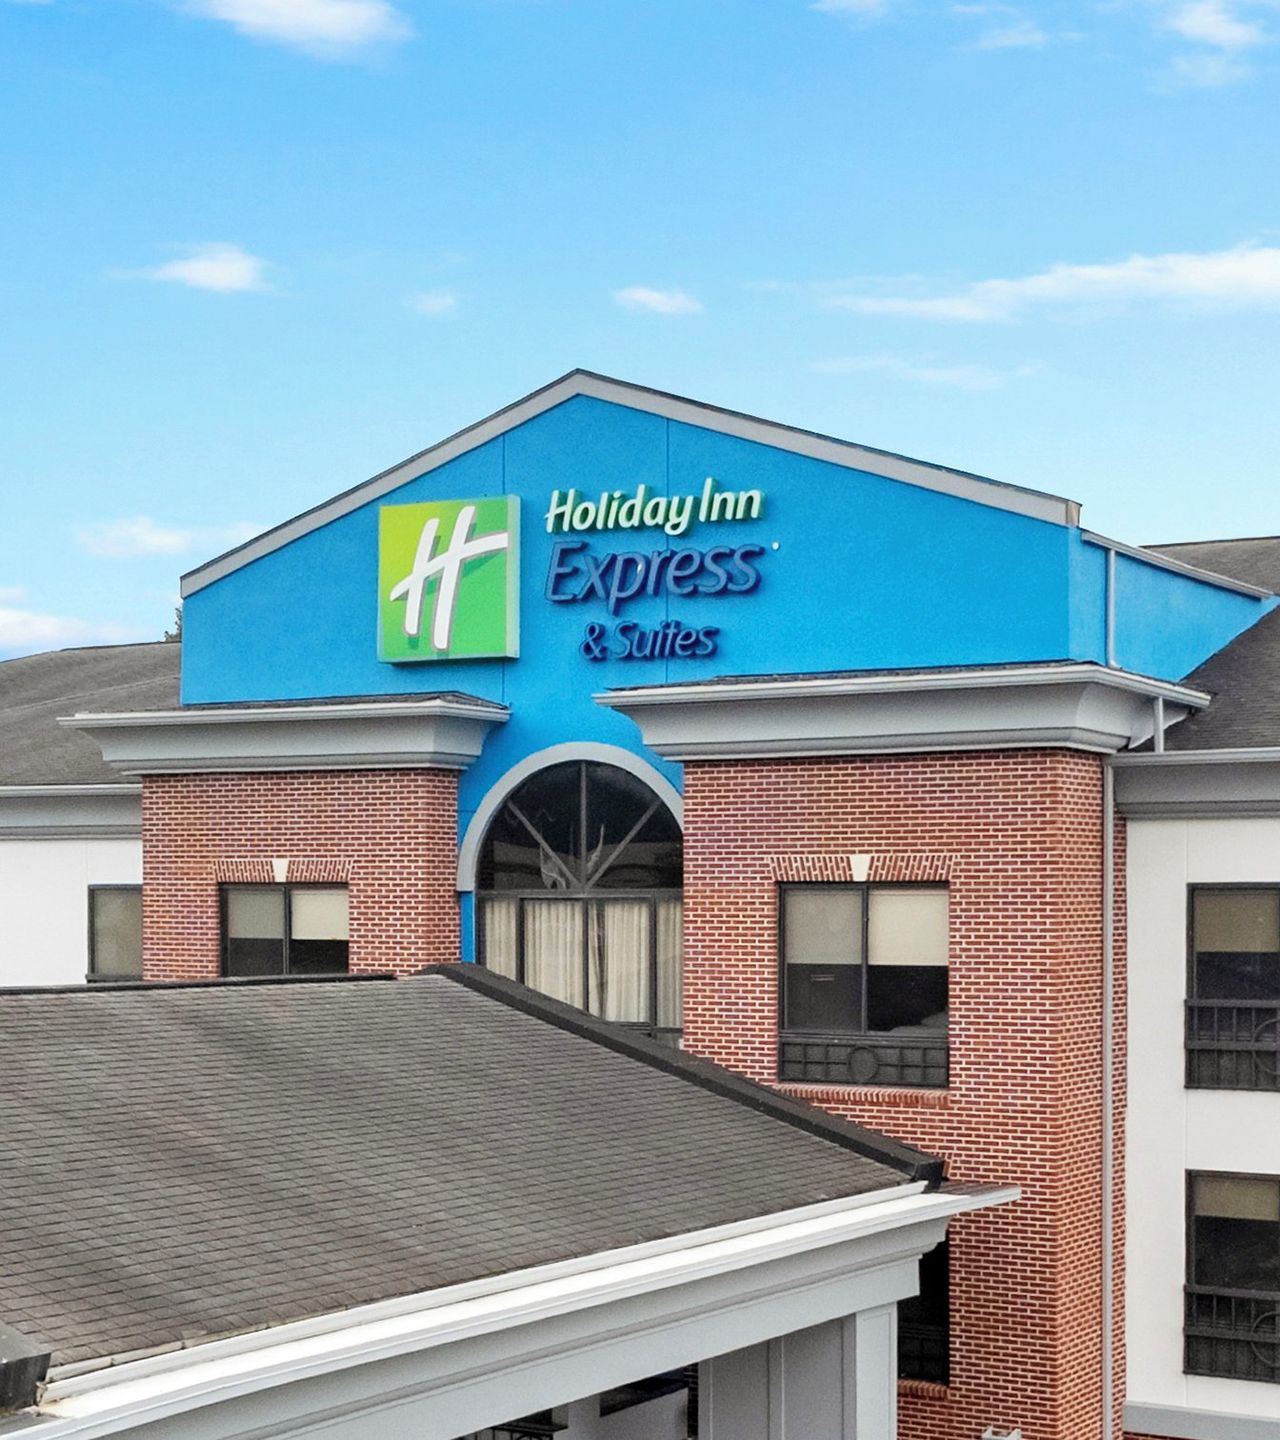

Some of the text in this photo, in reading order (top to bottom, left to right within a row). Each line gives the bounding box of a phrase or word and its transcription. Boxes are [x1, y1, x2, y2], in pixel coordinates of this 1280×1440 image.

[545, 477, 763, 536] Holiday Inn
[545, 540, 764, 617] Express
[579, 619, 720, 660] & Suites
